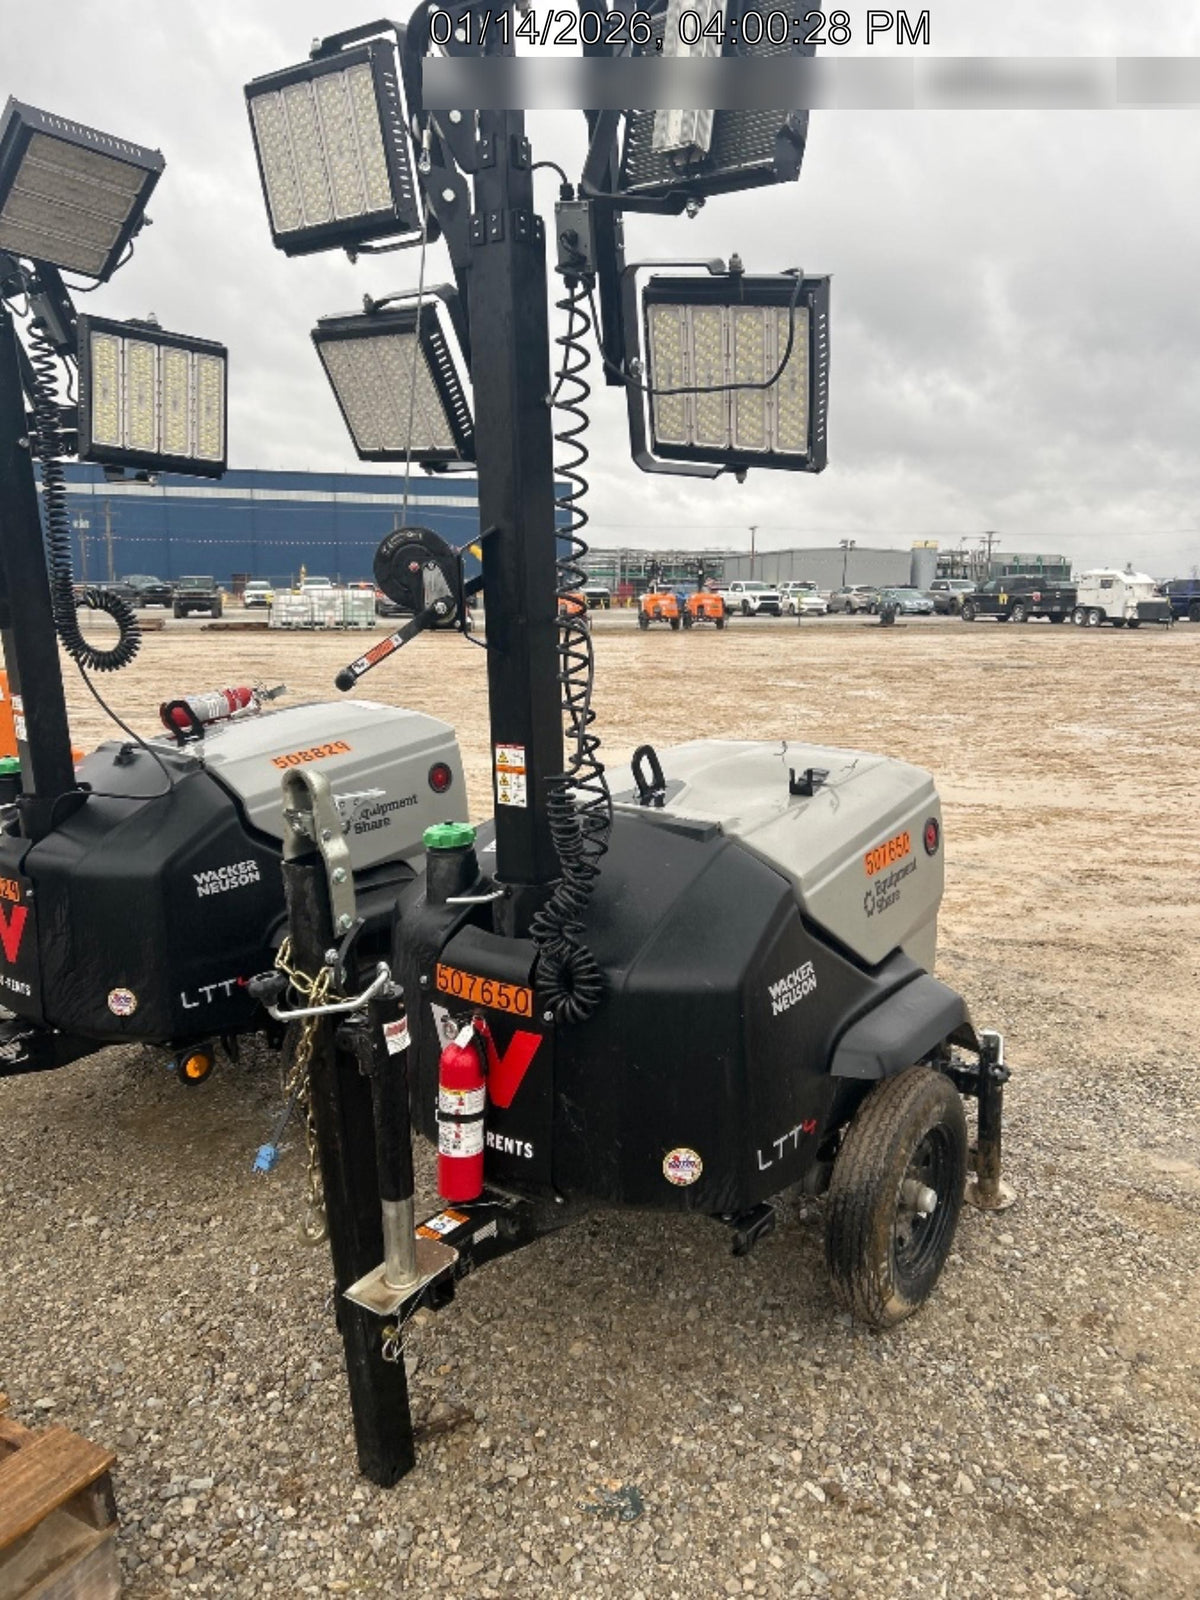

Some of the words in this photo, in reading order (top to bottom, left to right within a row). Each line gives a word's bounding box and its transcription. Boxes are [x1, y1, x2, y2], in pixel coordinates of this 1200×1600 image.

[353, 817, 391, 835] Share
[358, 794, 418, 821] quipment
[192, 860, 258, 884] WACKER
[865, 831, 910, 876] 507650
[196, 870, 260, 898] NEUSON
[438, 966, 529, 1014] 507650
[768, 960, 815, 1000] WACKER
[771, 974, 817, 1016] NEUSON
[757, 1119, 817, 1171] LTT4
